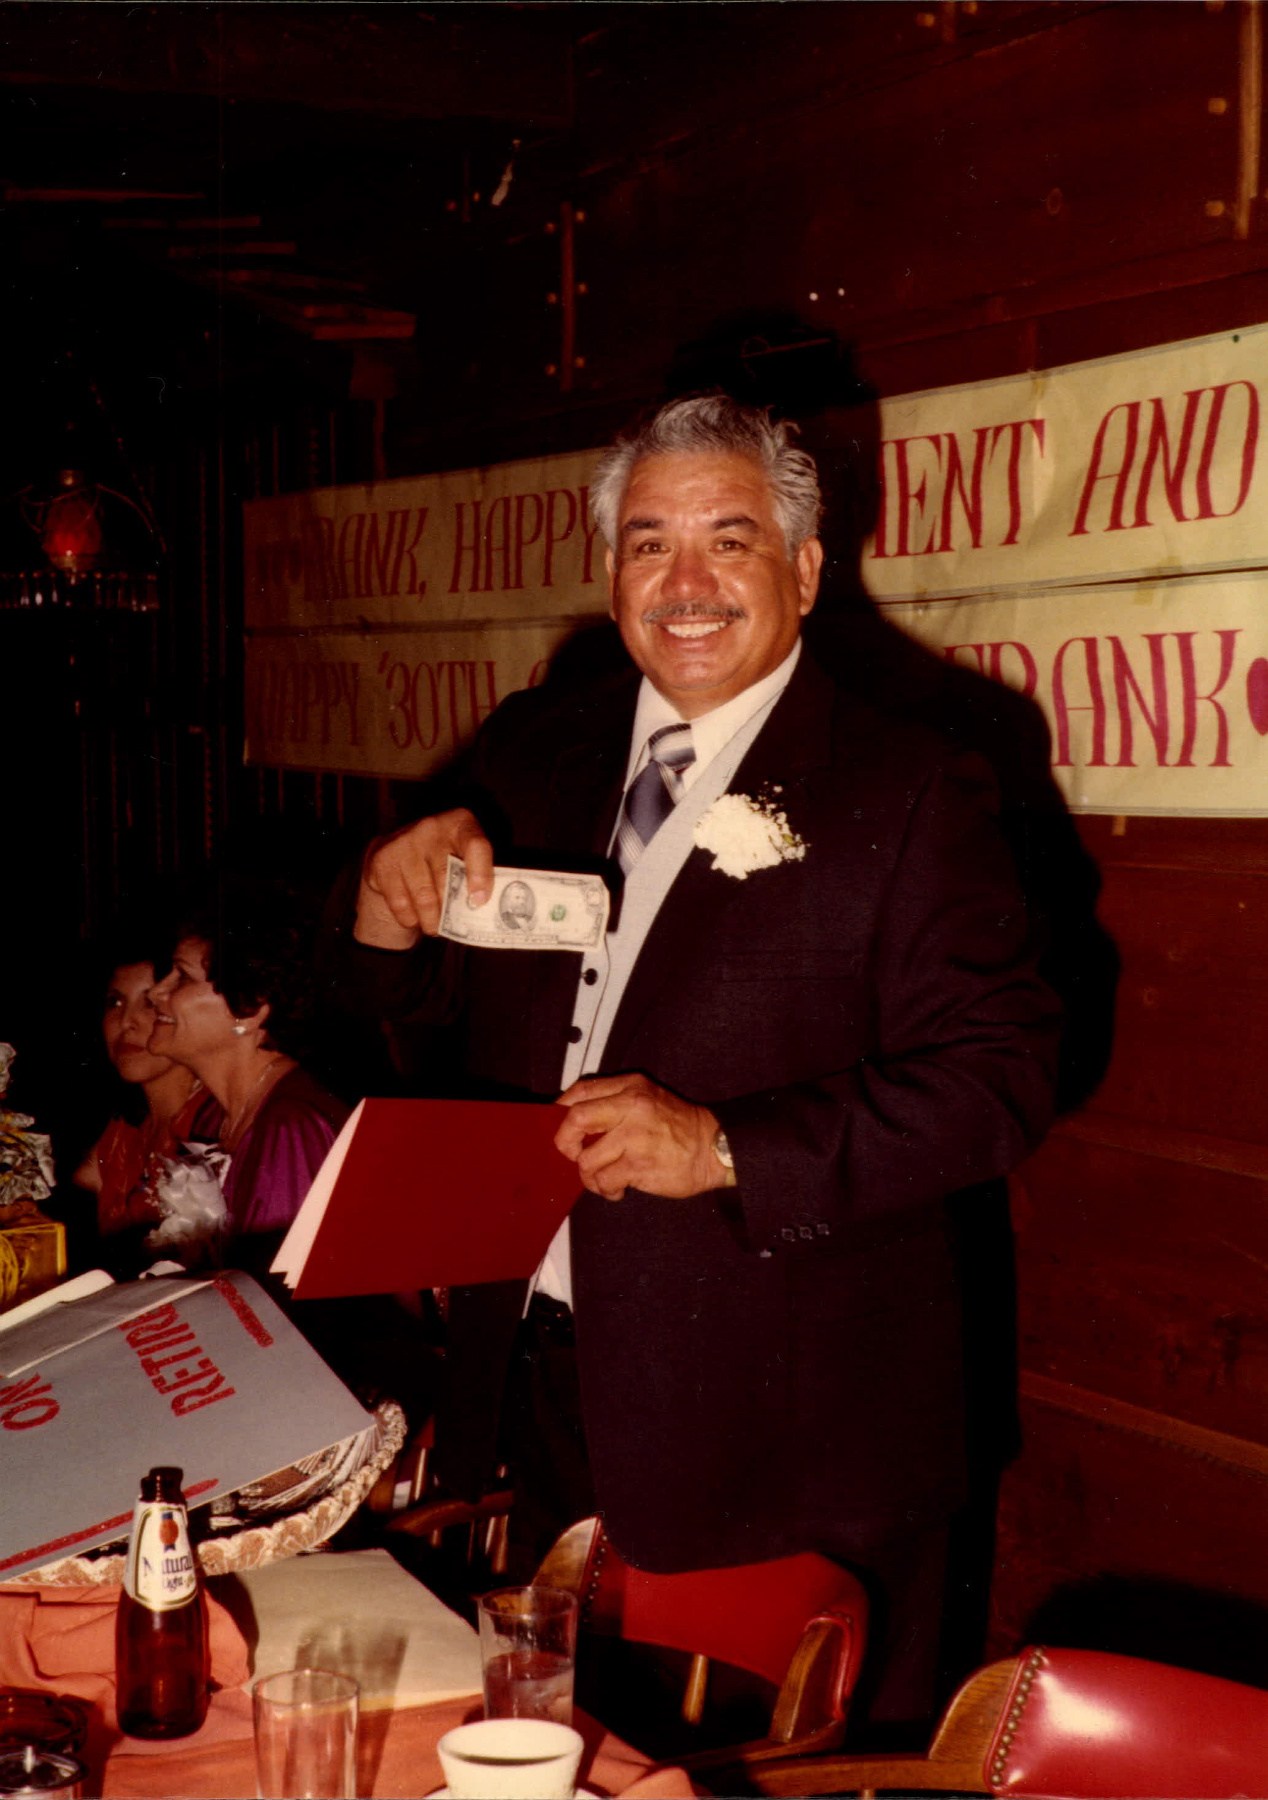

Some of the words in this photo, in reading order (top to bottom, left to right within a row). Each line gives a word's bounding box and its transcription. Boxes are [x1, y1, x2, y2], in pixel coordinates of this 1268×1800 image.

[448, 486, 598, 593] HAPPY
[1069, 380, 1260, 537] AND
[252, 661, 360, 746] HAPPY
[143, 1554, 193, 1577] Ntural
